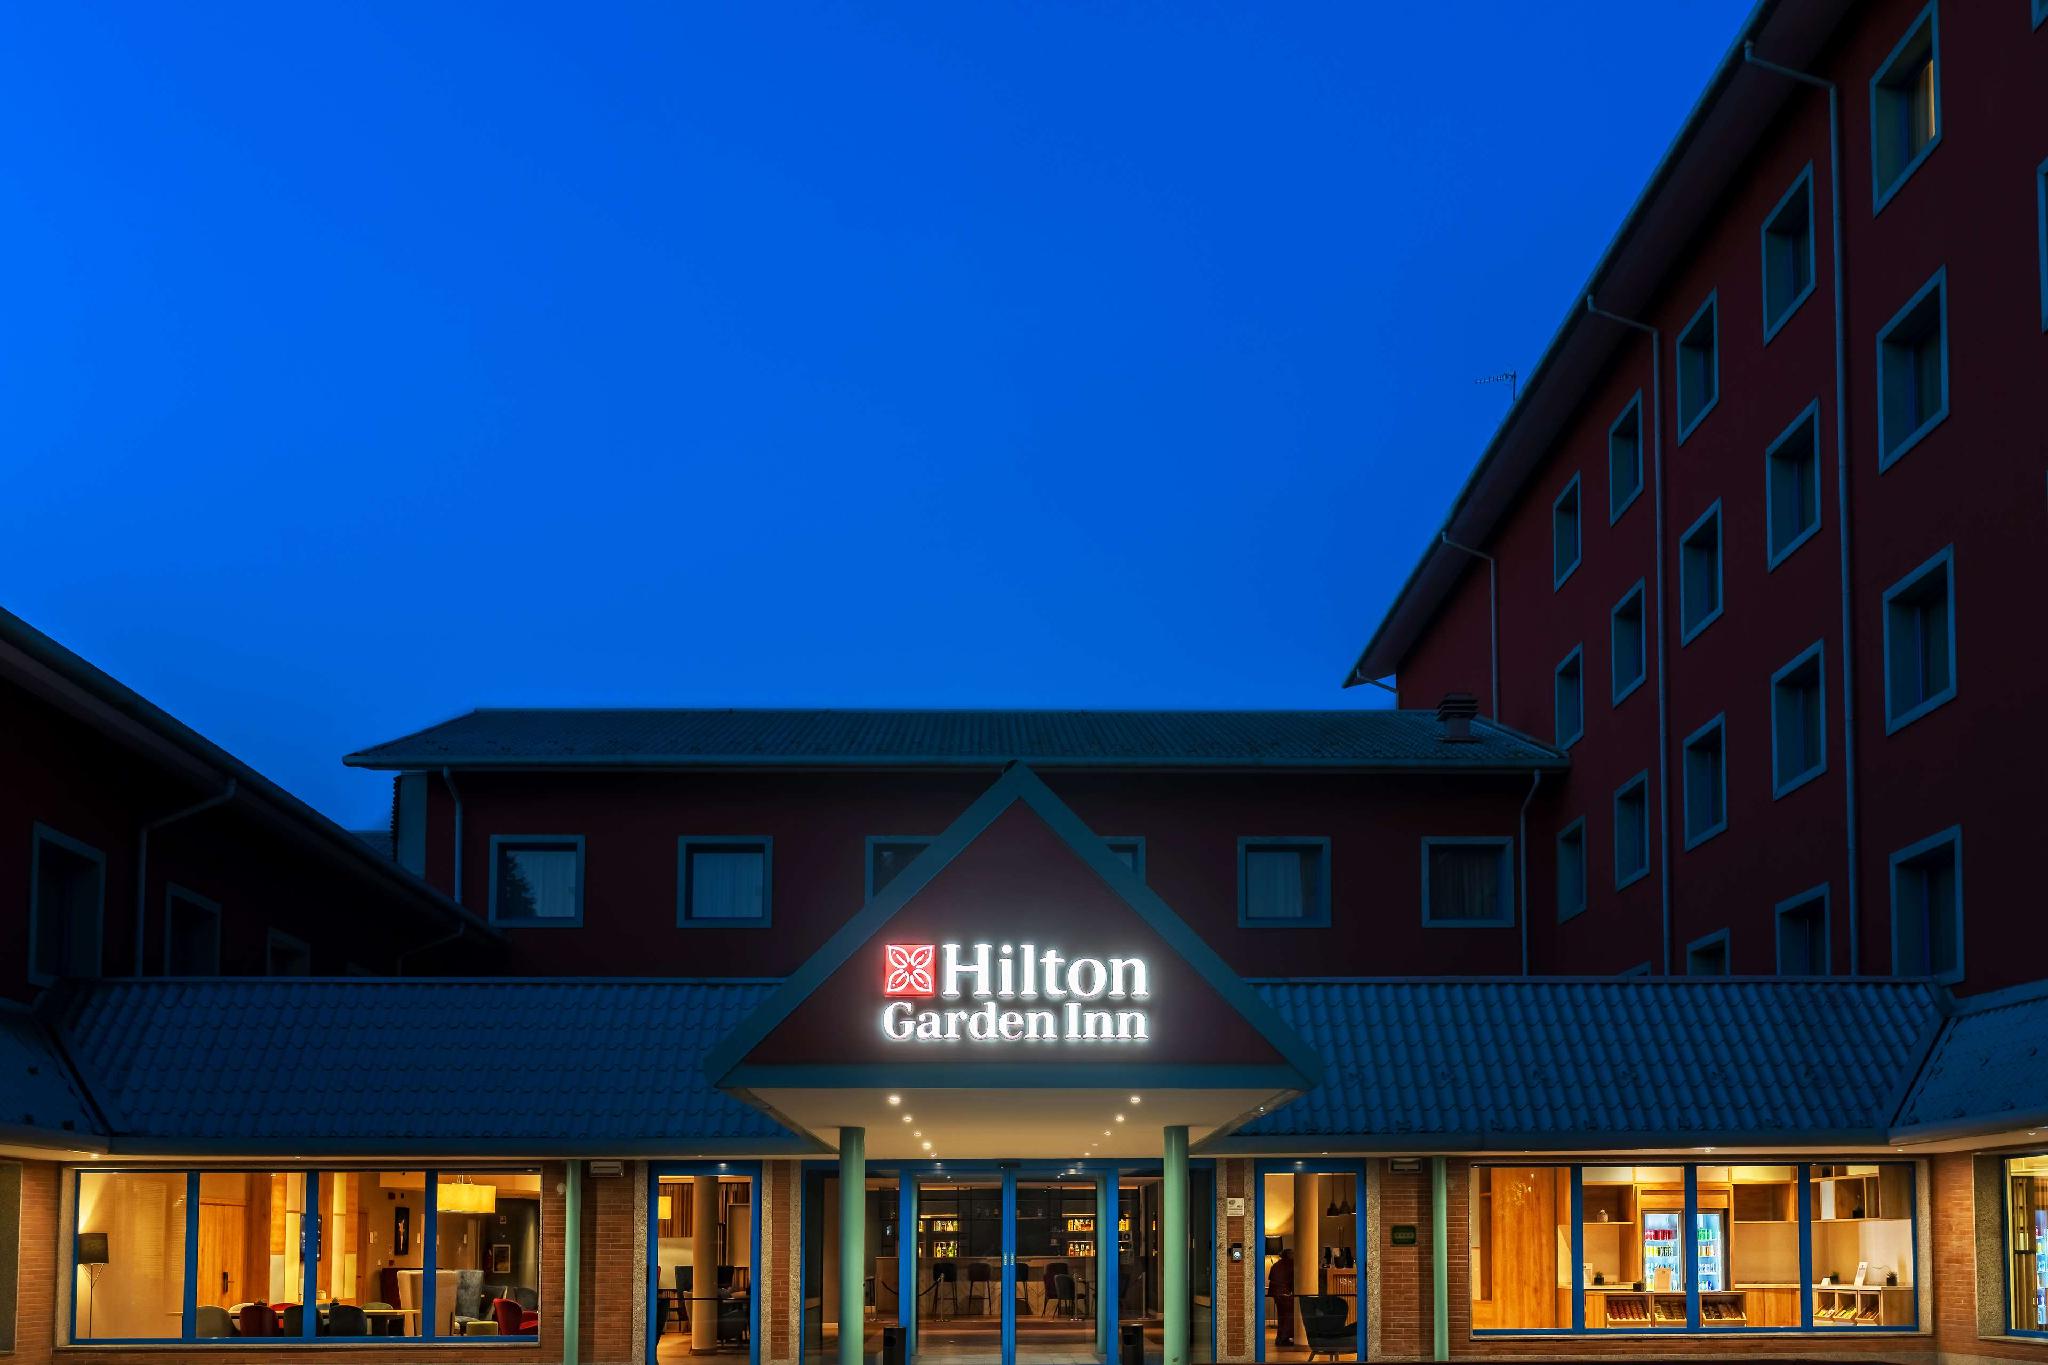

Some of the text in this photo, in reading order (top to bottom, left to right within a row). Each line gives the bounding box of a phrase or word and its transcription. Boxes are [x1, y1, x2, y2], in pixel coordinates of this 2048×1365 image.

[942, 943, 1149, 997] Hilton
[882, 1001, 1149, 1040] Garden Inn
